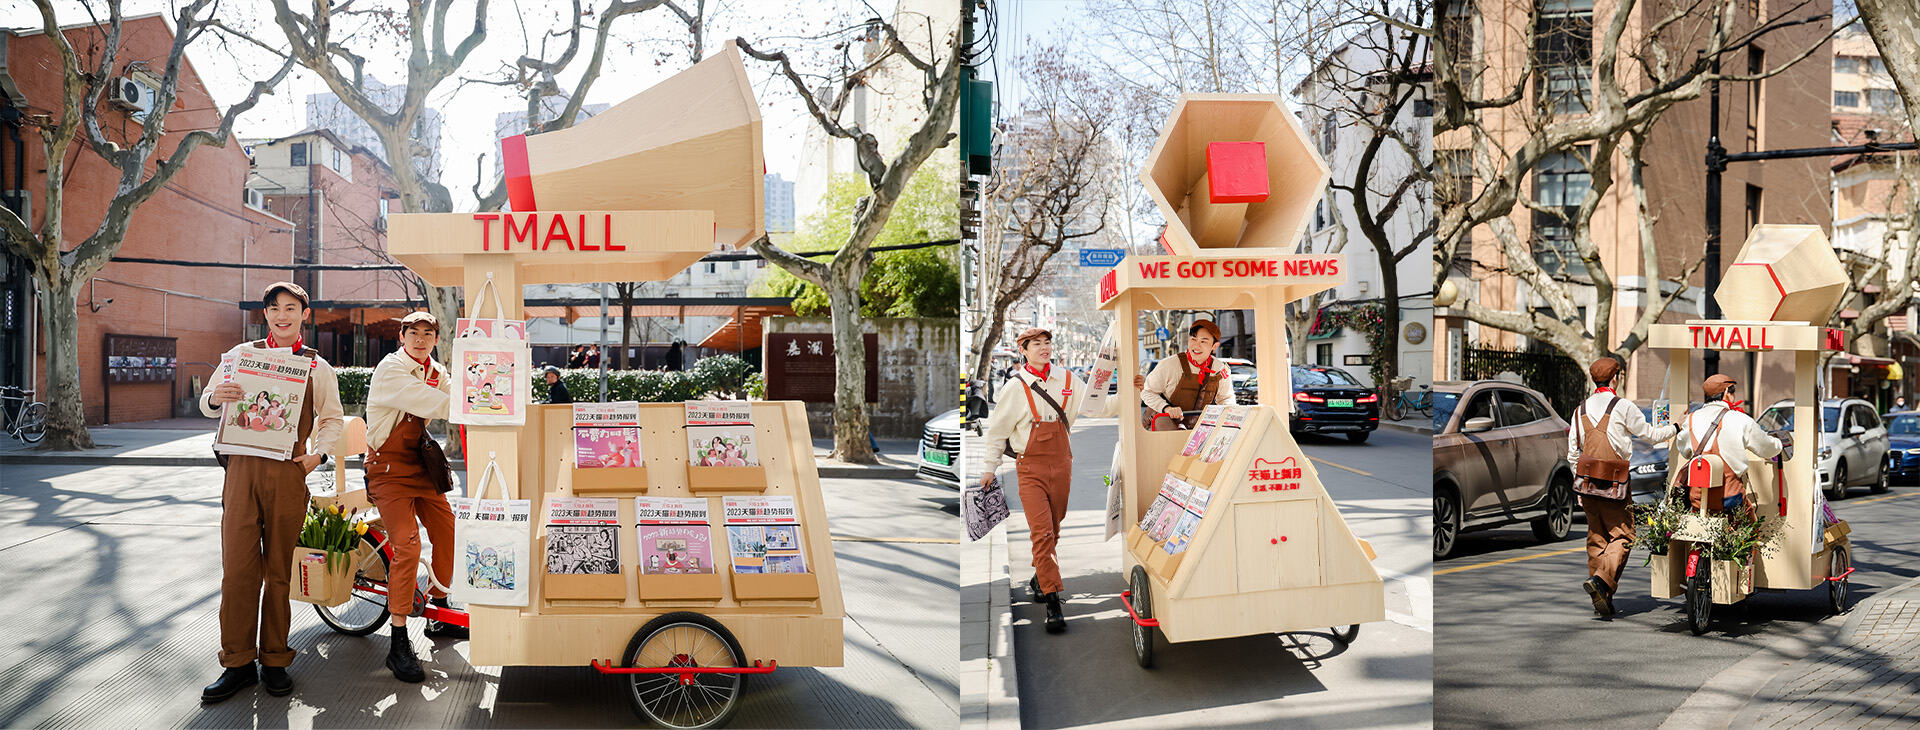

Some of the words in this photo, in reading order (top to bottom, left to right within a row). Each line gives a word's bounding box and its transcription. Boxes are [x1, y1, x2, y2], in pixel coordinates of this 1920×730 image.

[473, 213, 626, 251] TMALL
[1139, 261, 1170, 279] WE
[1176, 261, 1218, 279] GOT
[1222, 260, 1279, 278] SOME
[1284, 259, 1339, 277] NEWS
[1688, 326, 1774, 349] TMALL
